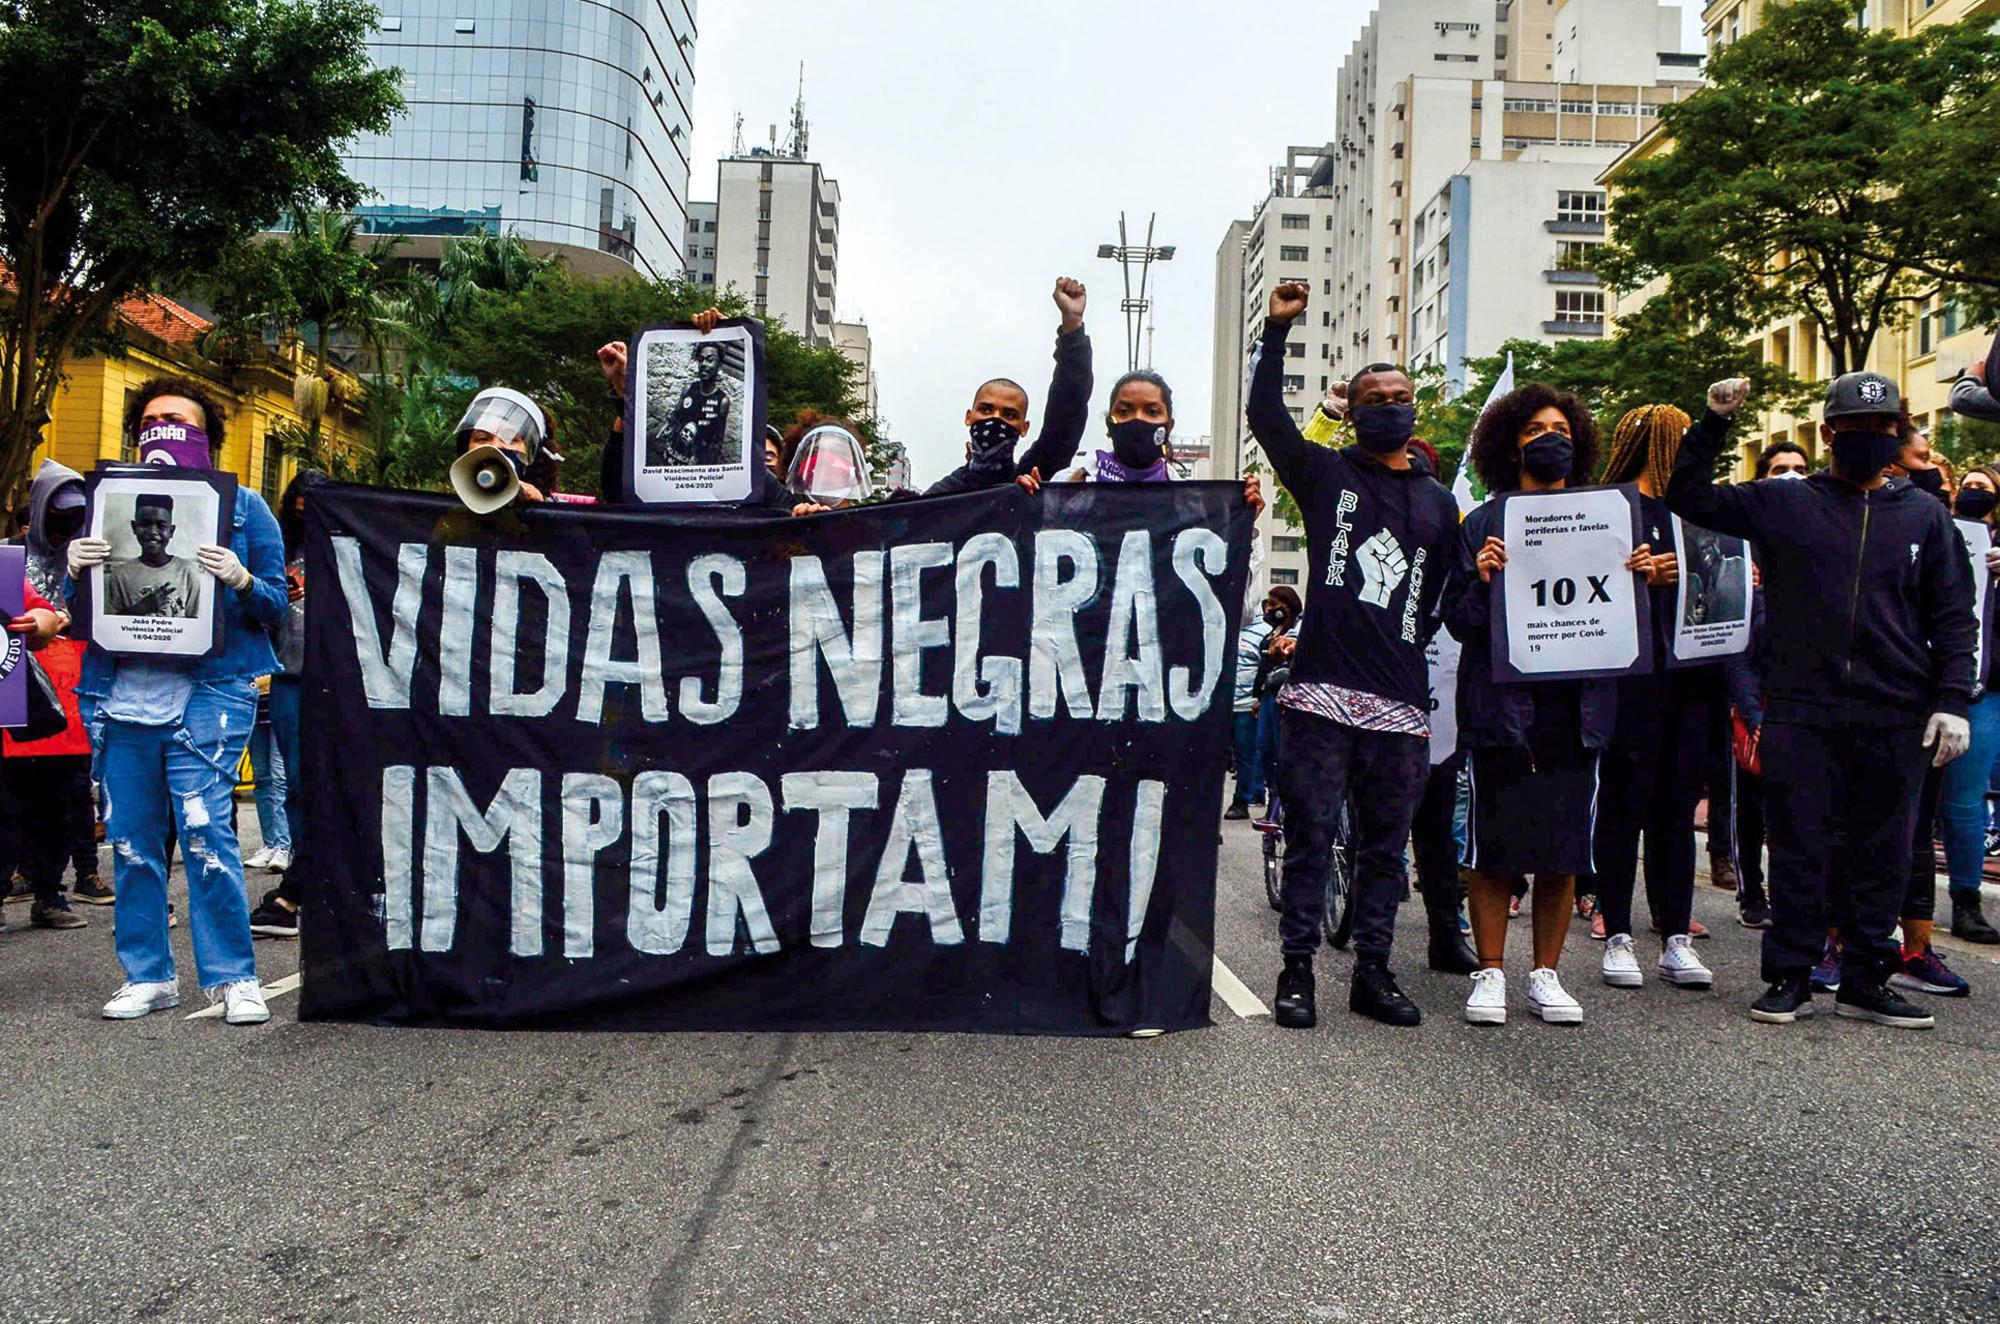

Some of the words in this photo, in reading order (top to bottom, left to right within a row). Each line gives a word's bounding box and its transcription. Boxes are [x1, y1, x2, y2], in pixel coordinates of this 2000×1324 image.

[1525, 514, 1573, 523] Moradores
[1575, 512, 1586, 521] de
[1525, 525, 1569, 536] periferias
[1579, 522, 1609, 532] favelas
[1325, 489, 1358, 587] BLACK
[1525, 538, 1542, 547] têm
[1530, 577, 1576, 607] 10
[1586, 574, 1612, 604] X
[1527, 621, 1548, 629] mais
[1550, 619, 1587, 628] chances
[330, 535, 746, 726] VIDAS
[788, 528, 1228, 735] NEGRAS
[1528, 633, 1559, 641] morrer
[1561, 632, 1577, 640] por
[1579, 629, 1607, 638] Covid-
[1529, 644, 1541, 652] 19
[1, 638, 22, 673] MEDO
